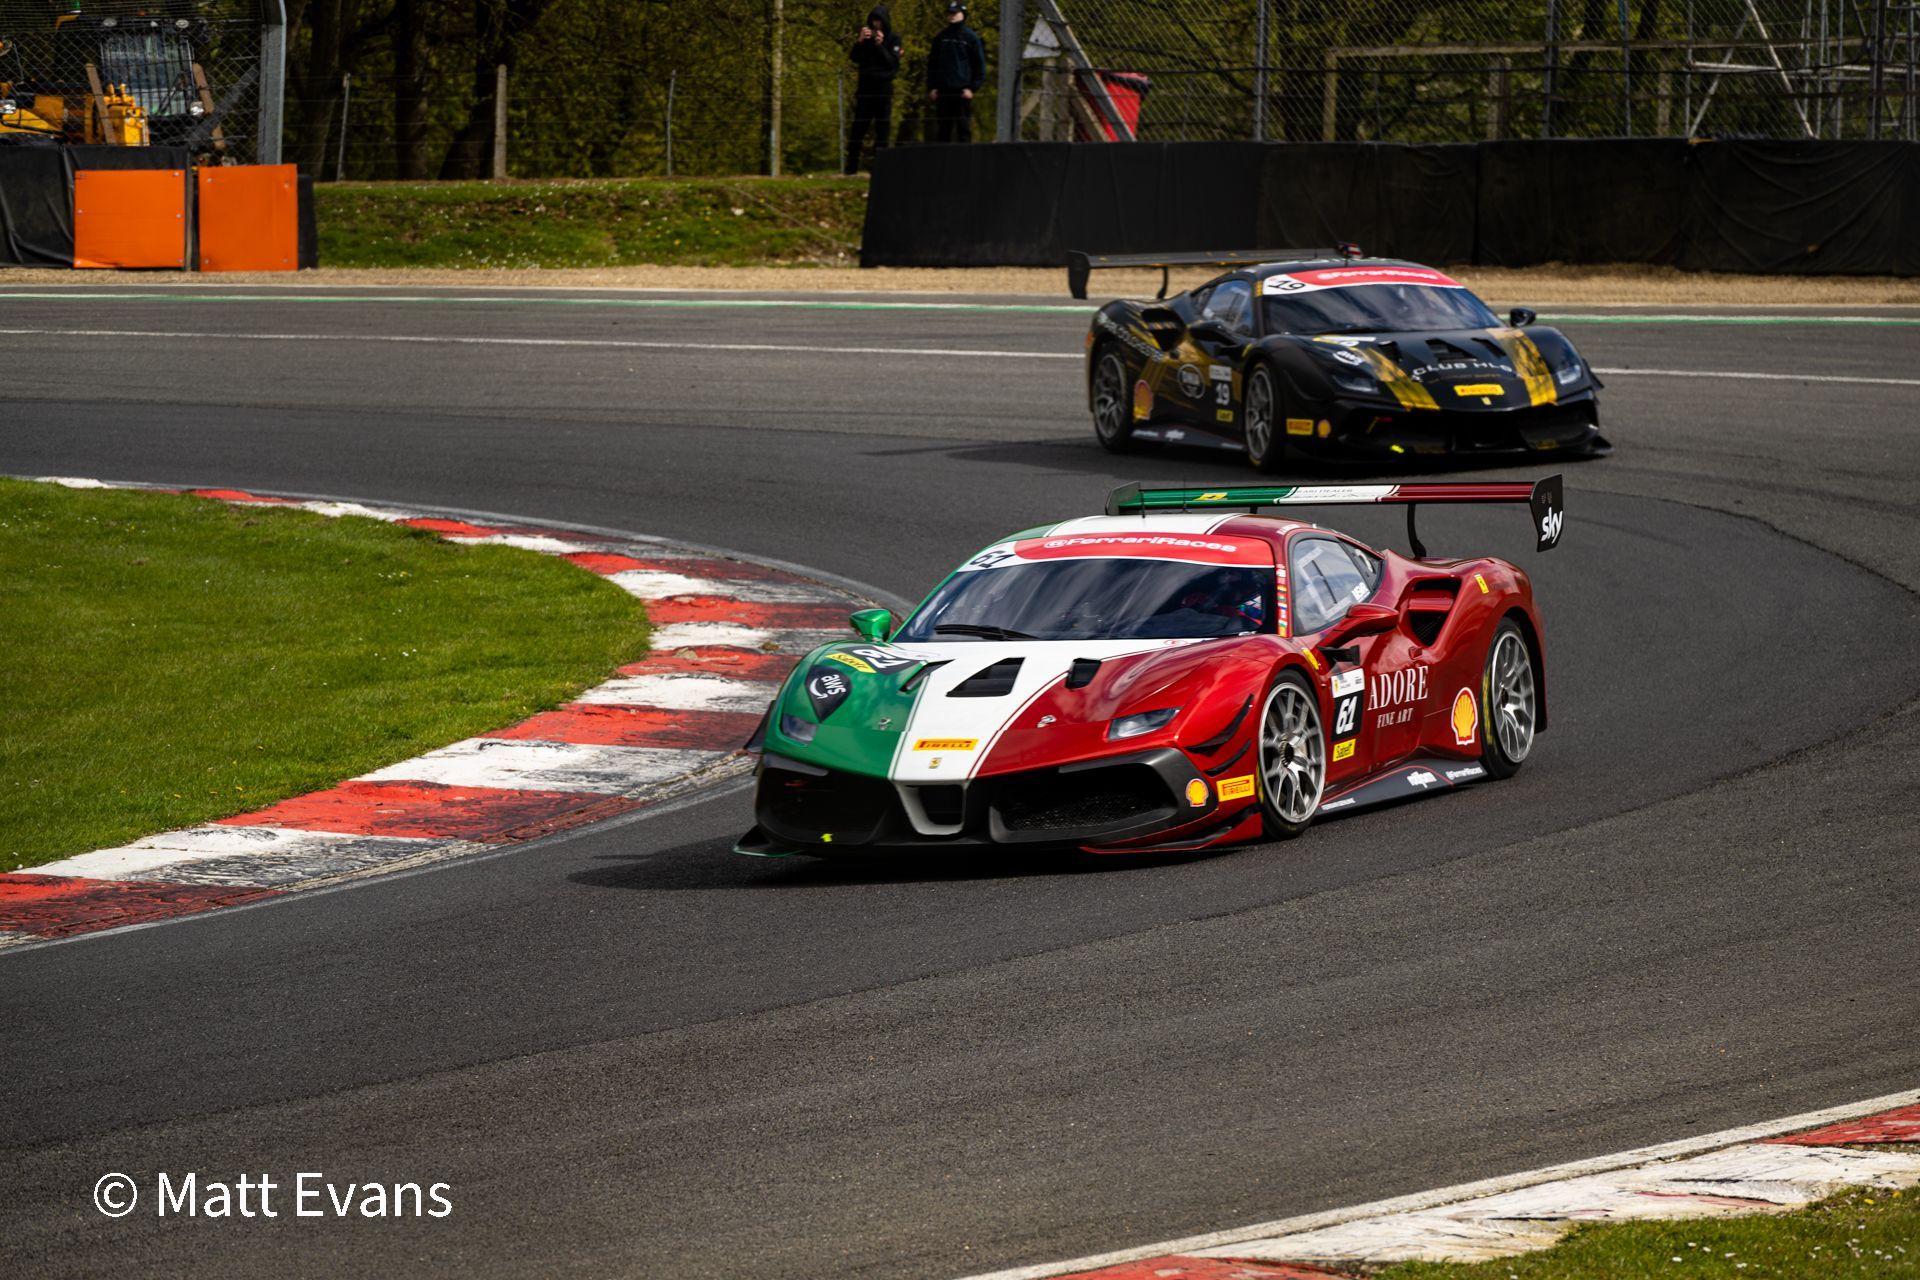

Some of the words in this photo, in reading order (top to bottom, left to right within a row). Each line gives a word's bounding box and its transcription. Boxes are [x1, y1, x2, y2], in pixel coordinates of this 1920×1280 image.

[1268, 279, 1306, 291] 19
[1412, 362, 1467, 376] CLUB
[1216, 383, 1230, 406] 19
[1541, 507, 1563, 544] sky
[1044, 536, 1237, 553] @FerrariRaces
[969, 550, 1013, 569] 61
[852, 649, 911, 669] 61
[821, 674, 847, 695] aws
[1367, 665, 1429, 711] ADORE
[1336, 696, 1358, 735] 61
[1377, 712, 1396, 729] FINE
[1396, 708, 1414, 724] ART
[918, 740, 973, 749] PIRELLI
[1222, 779, 1251, 797] PIRELLI
